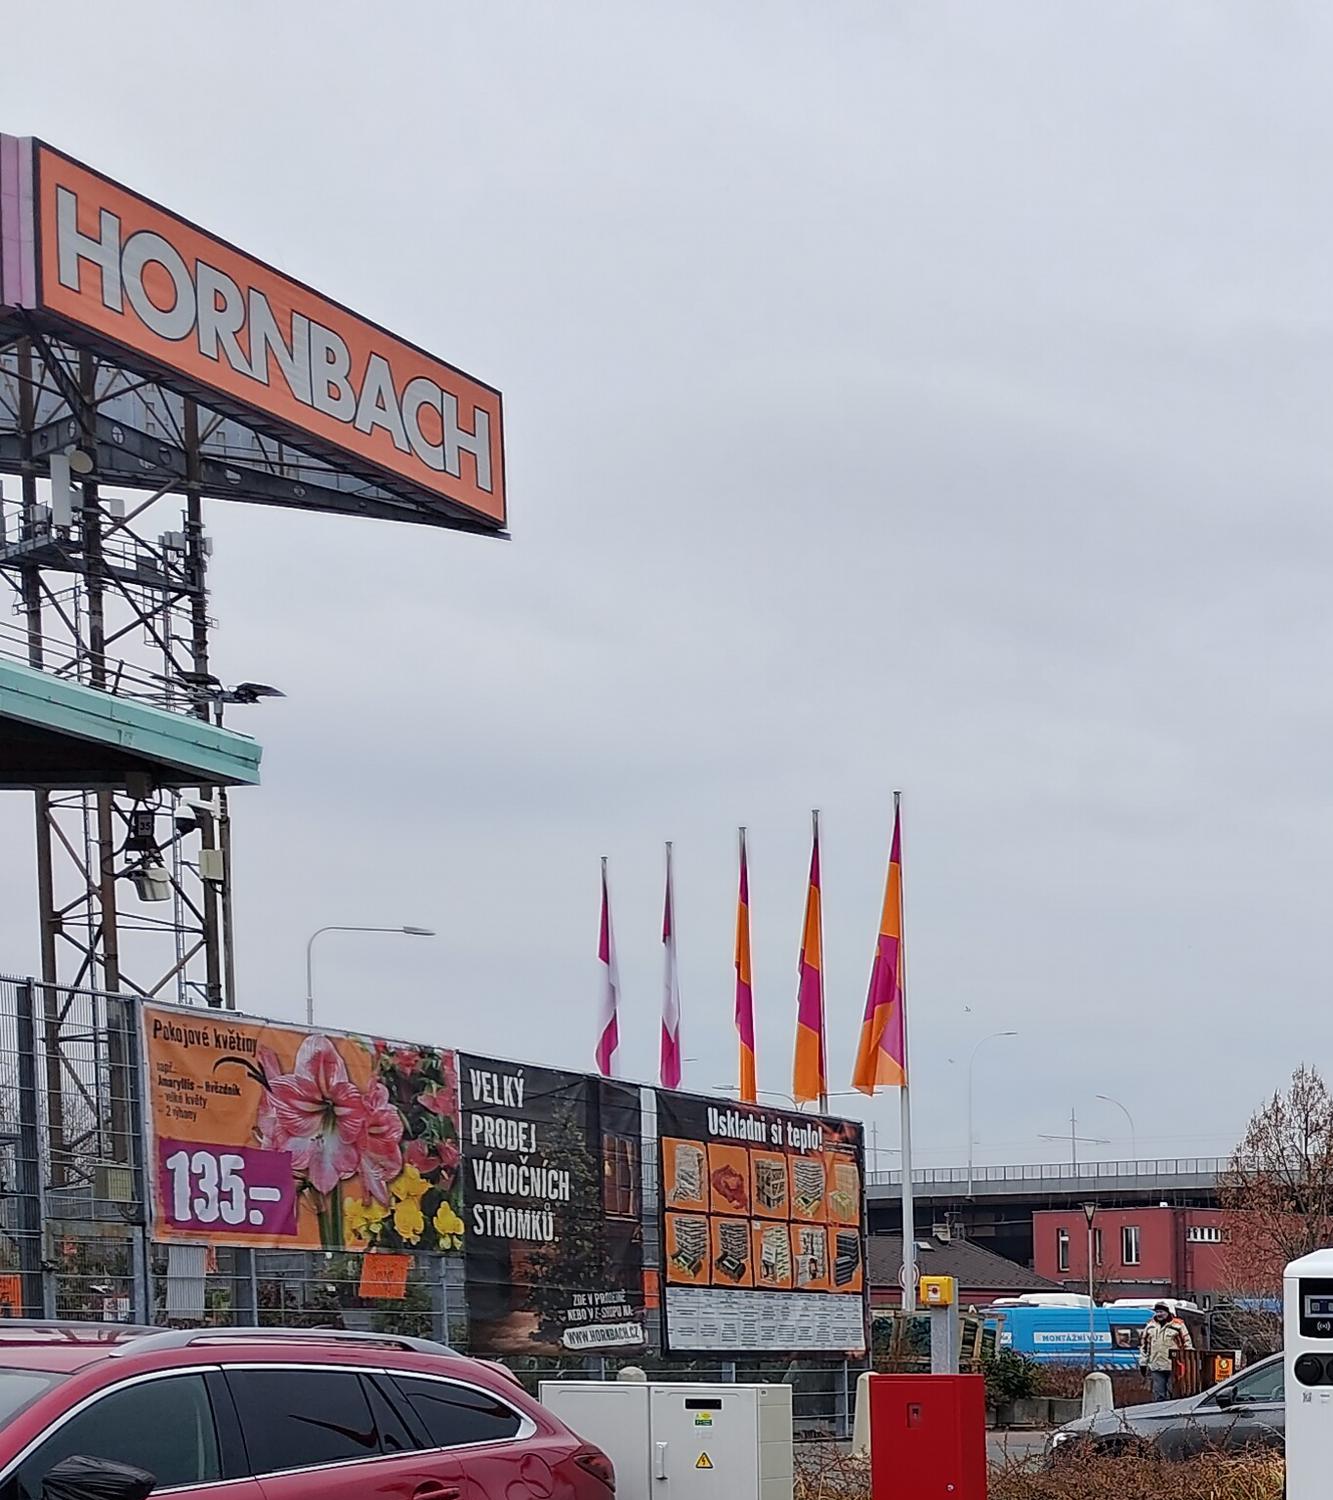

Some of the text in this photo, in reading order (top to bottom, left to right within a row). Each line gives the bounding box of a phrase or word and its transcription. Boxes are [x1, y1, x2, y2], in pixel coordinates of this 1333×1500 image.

[56, 183, 493, 493] HORNBACH
[153, 1019, 258, 1057] Pokojové květiny
[469, 1068, 525, 1109] VELKÝ
[471, 1114, 537, 1154] PRODEJ
[707, 1107, 766, 1143] Uskladni
[771, 1118, 783, 1145] si
[787, 1123, 823, 1155] teplo!
[472, 1152, 571, 1202] VÁNOČNÍCH
[472, 1202, 560, 1243] STROMKŮ.
[566, 1326, 640, 1345] WWW.HORNBACH.CZ
